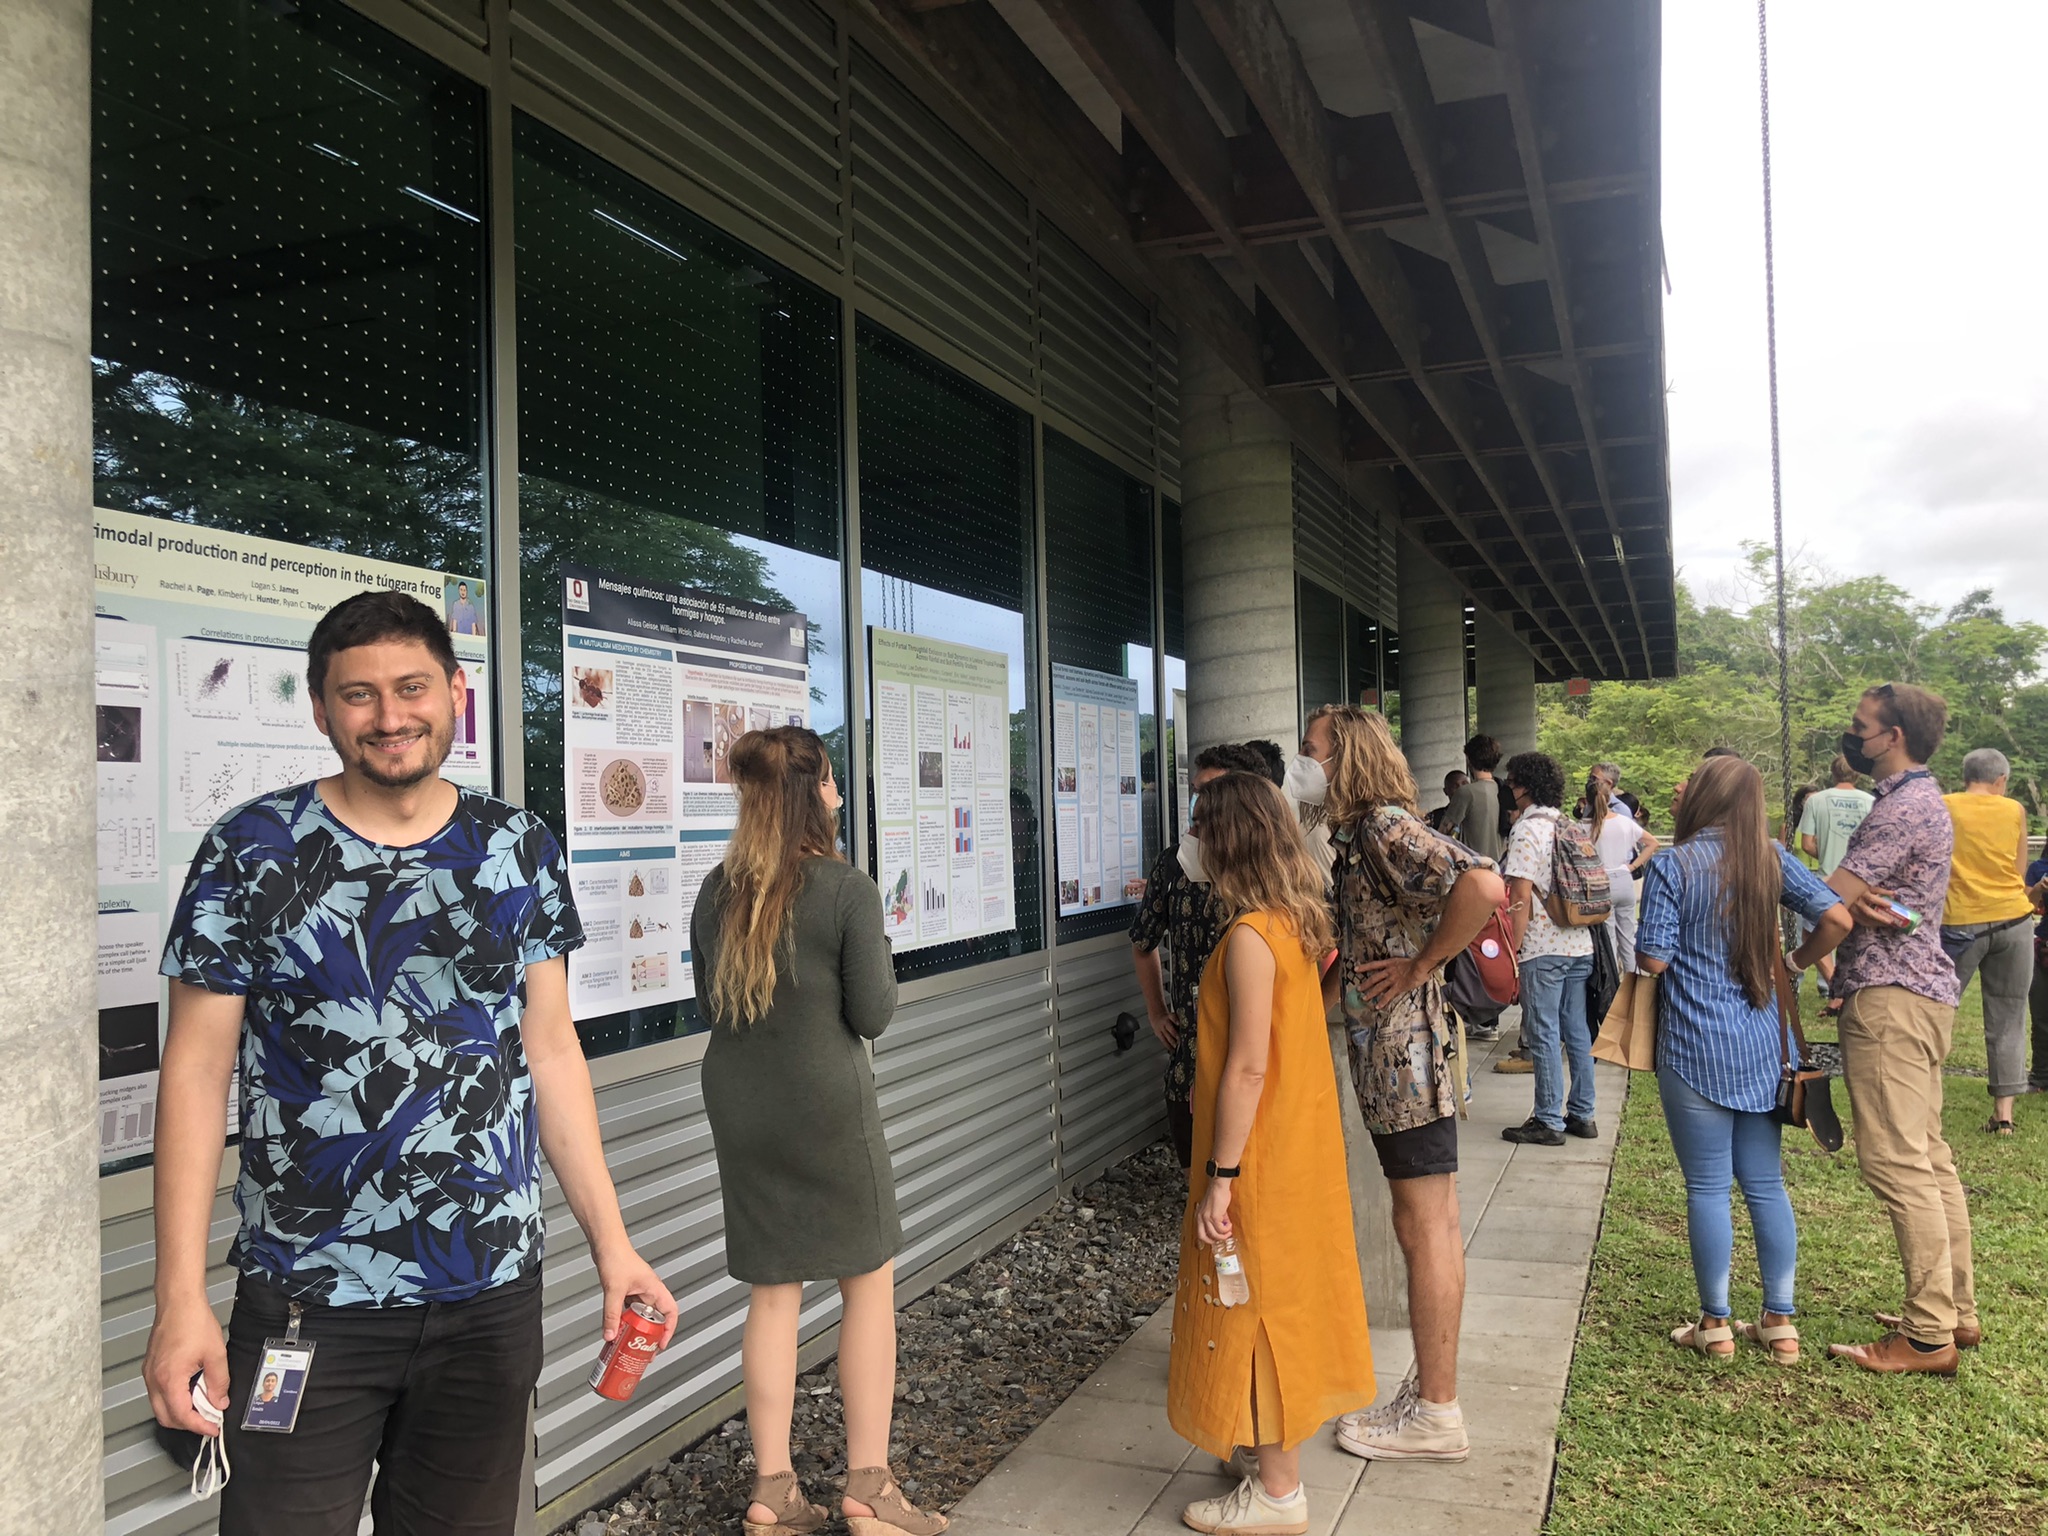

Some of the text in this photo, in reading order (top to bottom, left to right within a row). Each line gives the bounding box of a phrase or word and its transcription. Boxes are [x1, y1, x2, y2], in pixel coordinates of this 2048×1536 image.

[93, 523, 442, 599] imodal production and perception in the túngara frog
[160, 580, 186, 592] Rachel
[187, 584, 194, 592] A.
[197, 586, 216, 598] Page,
[218, 588, 248, 602] Kimberly
[250, 594, 255, 602] L.
[256, 595, 281, 606] Hunter,
[283, 598, 298, 609] Ryan
[300, 600, 306, 608] C.
[308, 602, 328, 613] Taylor,
[251, 580, 299, 595] Logan S. James
[599, 578, 780, 625] Mensajes químicos: una asociación de 55 millones de años entre
[672, 605, 726, 625] hormigas y hongos.
[201, 628, 244, 640] Correlations
[253, 636, 289, 646] production
[627, 618, 641, 628] Alissa
[660, 623, 677, 634] William
[693, 630, 709, 640] Sabrina
[584, 639, 611, 649] MUTUALISM
[612, 643, 633, 652] MEDIATED
[640, 648, 662, 656] CHEMISTRY
[1830, 799, 1858, 810] VANS
